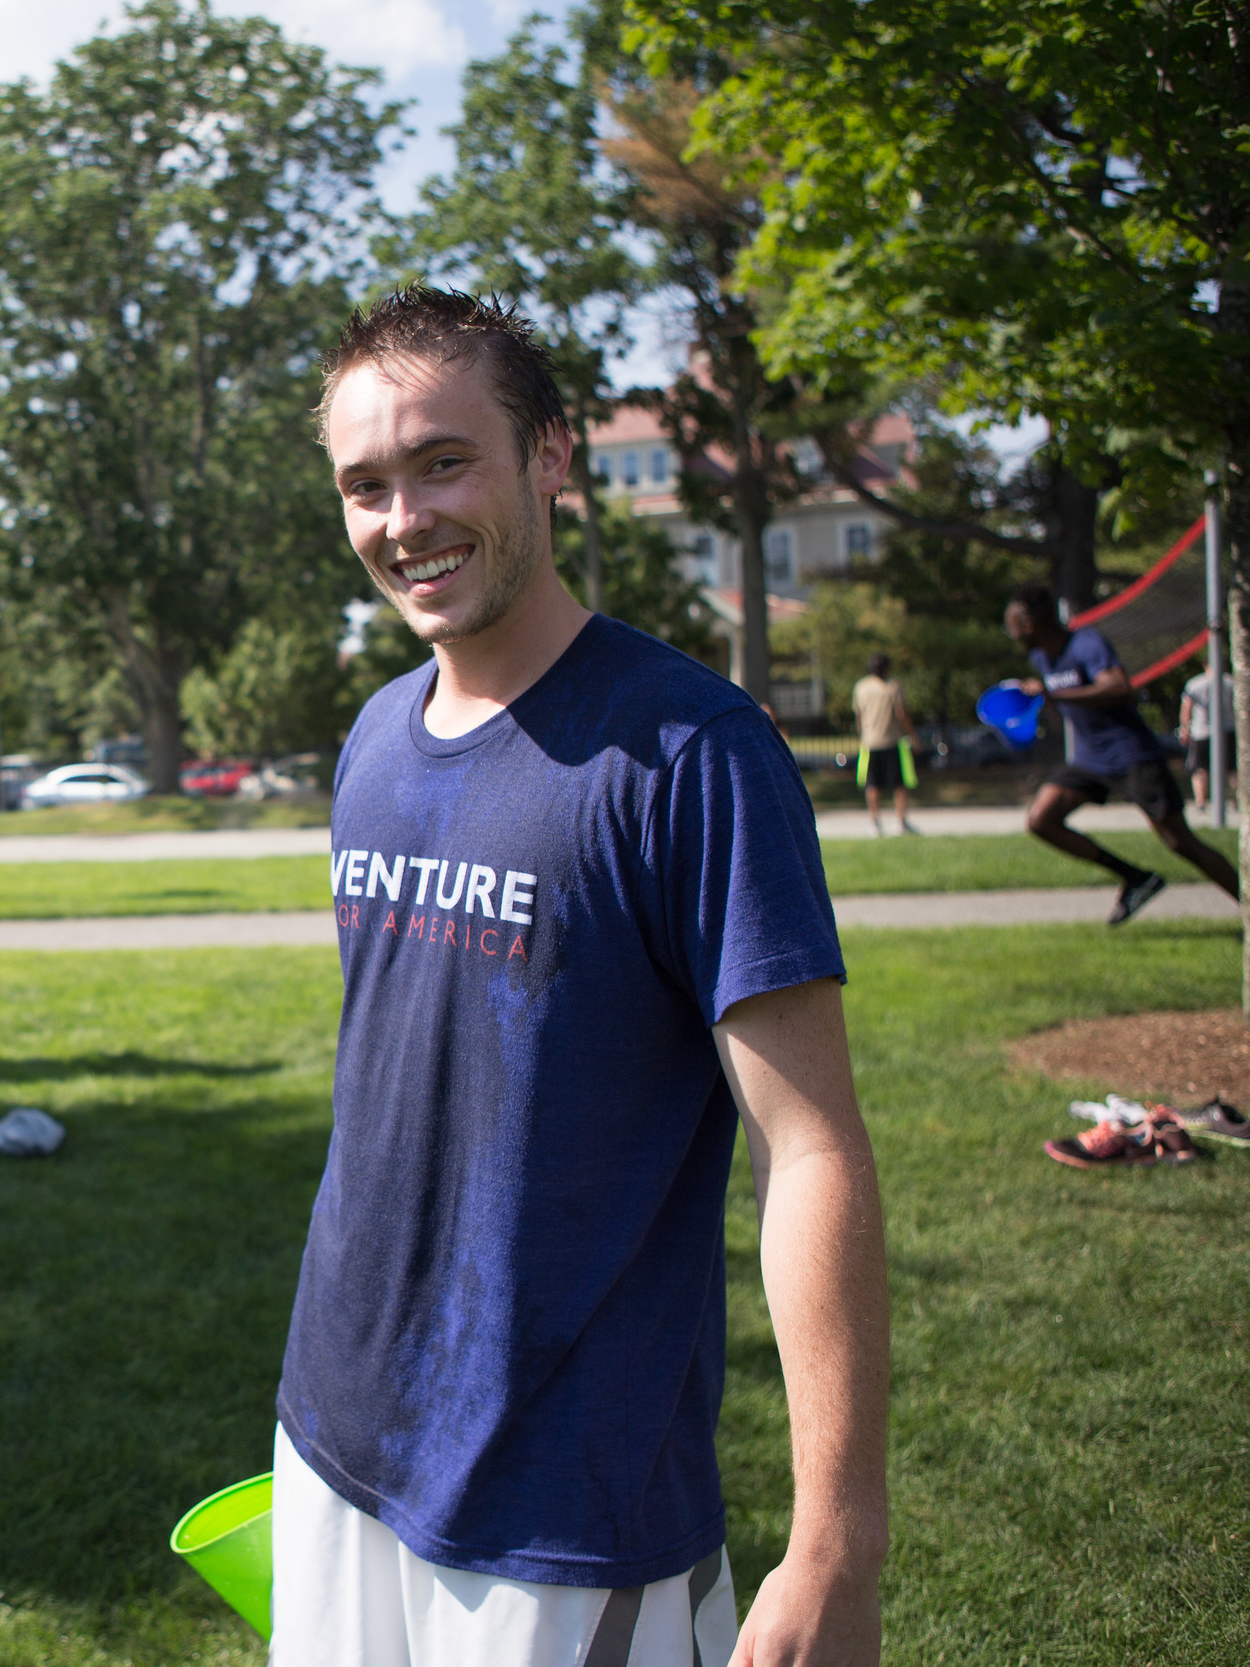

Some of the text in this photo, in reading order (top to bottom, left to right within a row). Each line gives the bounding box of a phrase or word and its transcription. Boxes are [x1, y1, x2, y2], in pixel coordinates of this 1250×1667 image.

[331, 849, 538, 926] VENTURE
[337, 904, 529, 963] OR AMERICA
